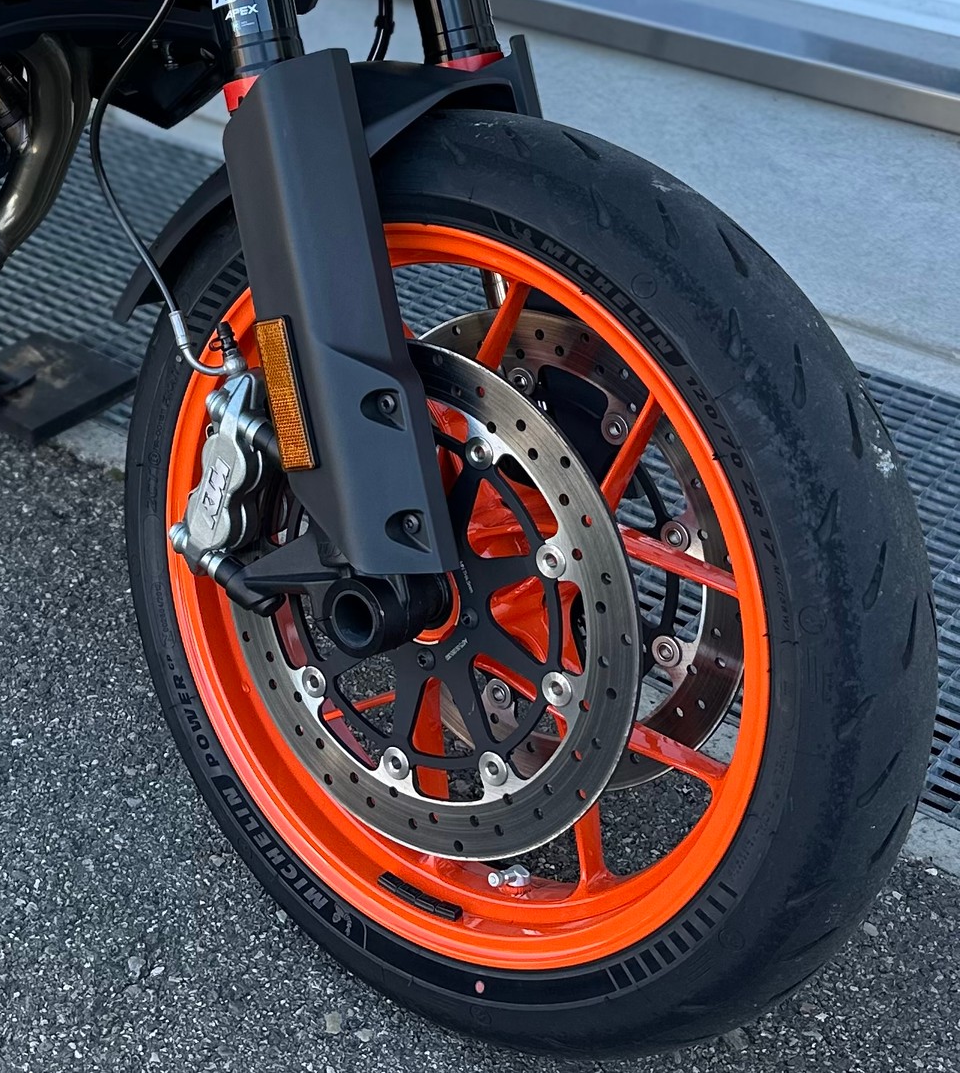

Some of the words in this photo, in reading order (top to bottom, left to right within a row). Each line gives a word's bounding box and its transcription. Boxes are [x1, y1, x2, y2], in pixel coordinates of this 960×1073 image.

[225, 3, 258, 20] APEX
[541, 239, 673, 354] MICHELIN
[686, 376, 743, 468] 120/70
[742, 479, 764, 518] ZR
[760, 528, 777, 559] 17
[201, 456, 230, 531] KTM
[166, 654, 175, 670] GP
[173, 674, 220, 767] POWER
[222, 787, 328, 909] MICHELIN
